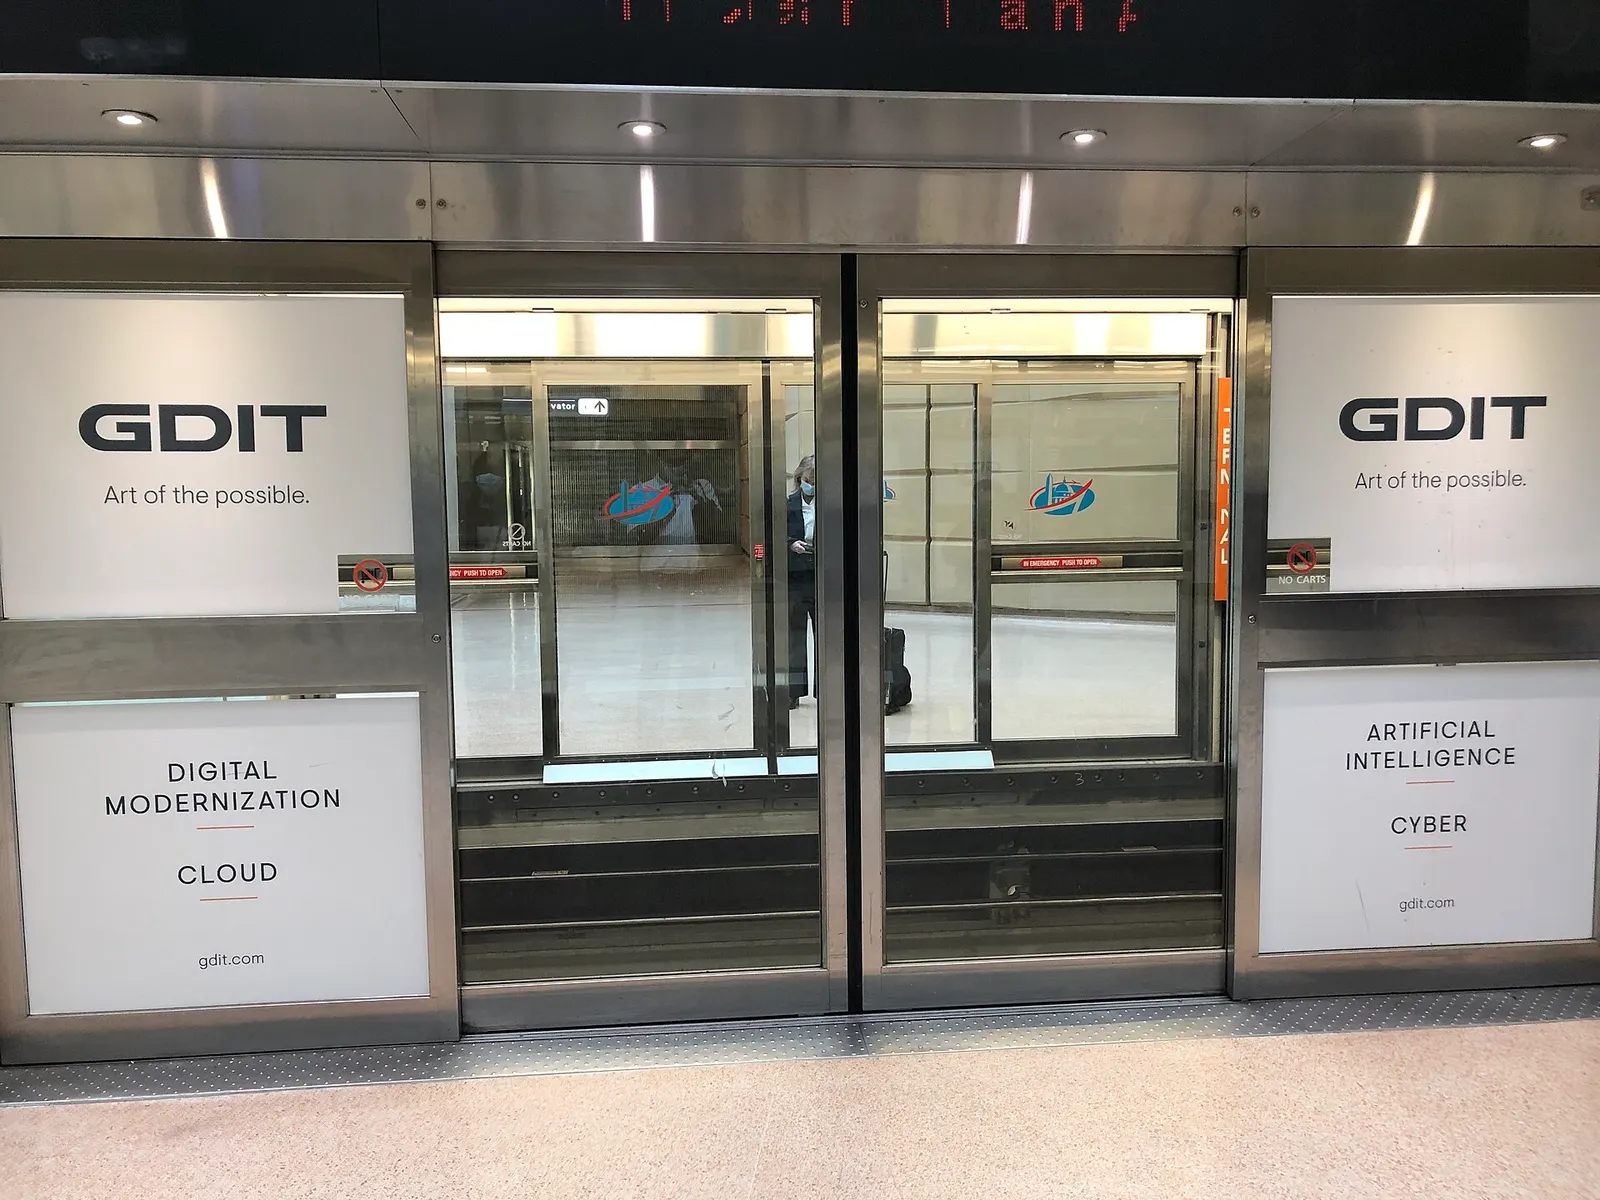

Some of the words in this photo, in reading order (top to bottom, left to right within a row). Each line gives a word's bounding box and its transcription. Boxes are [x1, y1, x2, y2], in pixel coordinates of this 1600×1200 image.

[79, 403, 327, 452] GDIT
[1339, 396, 1547, 441] GDIT
[1220, 408, 1231, 564] TERMNAL
[1355, 472, 1383, 489] Art
[1387, 471, 1407, 489] of
[1411, 471, 1442, 488] the
[1447, 469, 1527, 491] possible.
[104, 485, 137, 504] Art
[144, 484, 167, 504] of
[173, 485, 209, 504] the
[216, 485, 310, 508] possible.
[1279, 576, 1293, 585] NO
[1297, 575, 1326, 584] CARTS
[1367, 720, 1496, 741] ARTIFICIAL
[1346, 748, 1516, 770] INTELLIGENCE
[168, 760, 277, 782] DIGITAL
[105, 789, 340, 815] MODERNIZATION
[1391, 815, 1467, 834] CYBER
[177, 863, 277, 885] CLOUD
[1399, 898, 1455, 912] gdit.com
[198, 954, 265, 970] gdit.com
